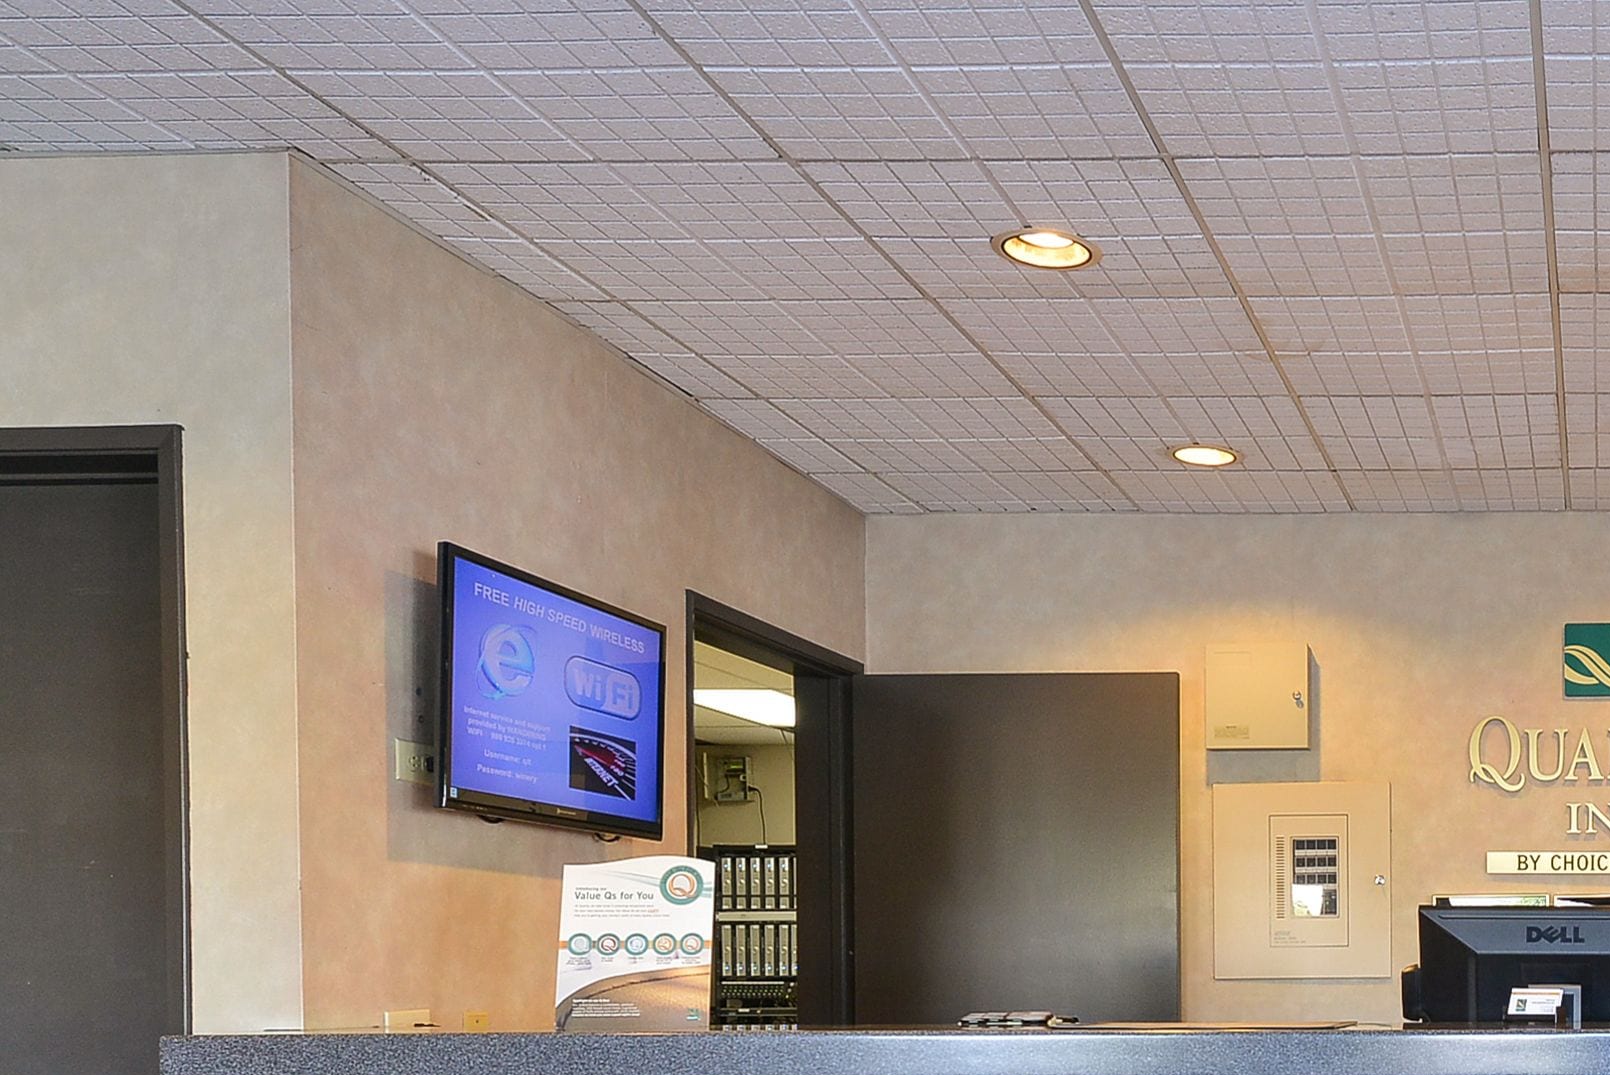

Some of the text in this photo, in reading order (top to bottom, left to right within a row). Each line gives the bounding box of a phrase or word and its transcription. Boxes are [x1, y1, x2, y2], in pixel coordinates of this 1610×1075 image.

[474, 582, 645, 654] FREE HIGH SPEED WIRELESS
[1517, 854, 1540, 872] BY
[574, 891, 654, 900] Value Qs for You
[1526, 925, 1585, 944] DELL
